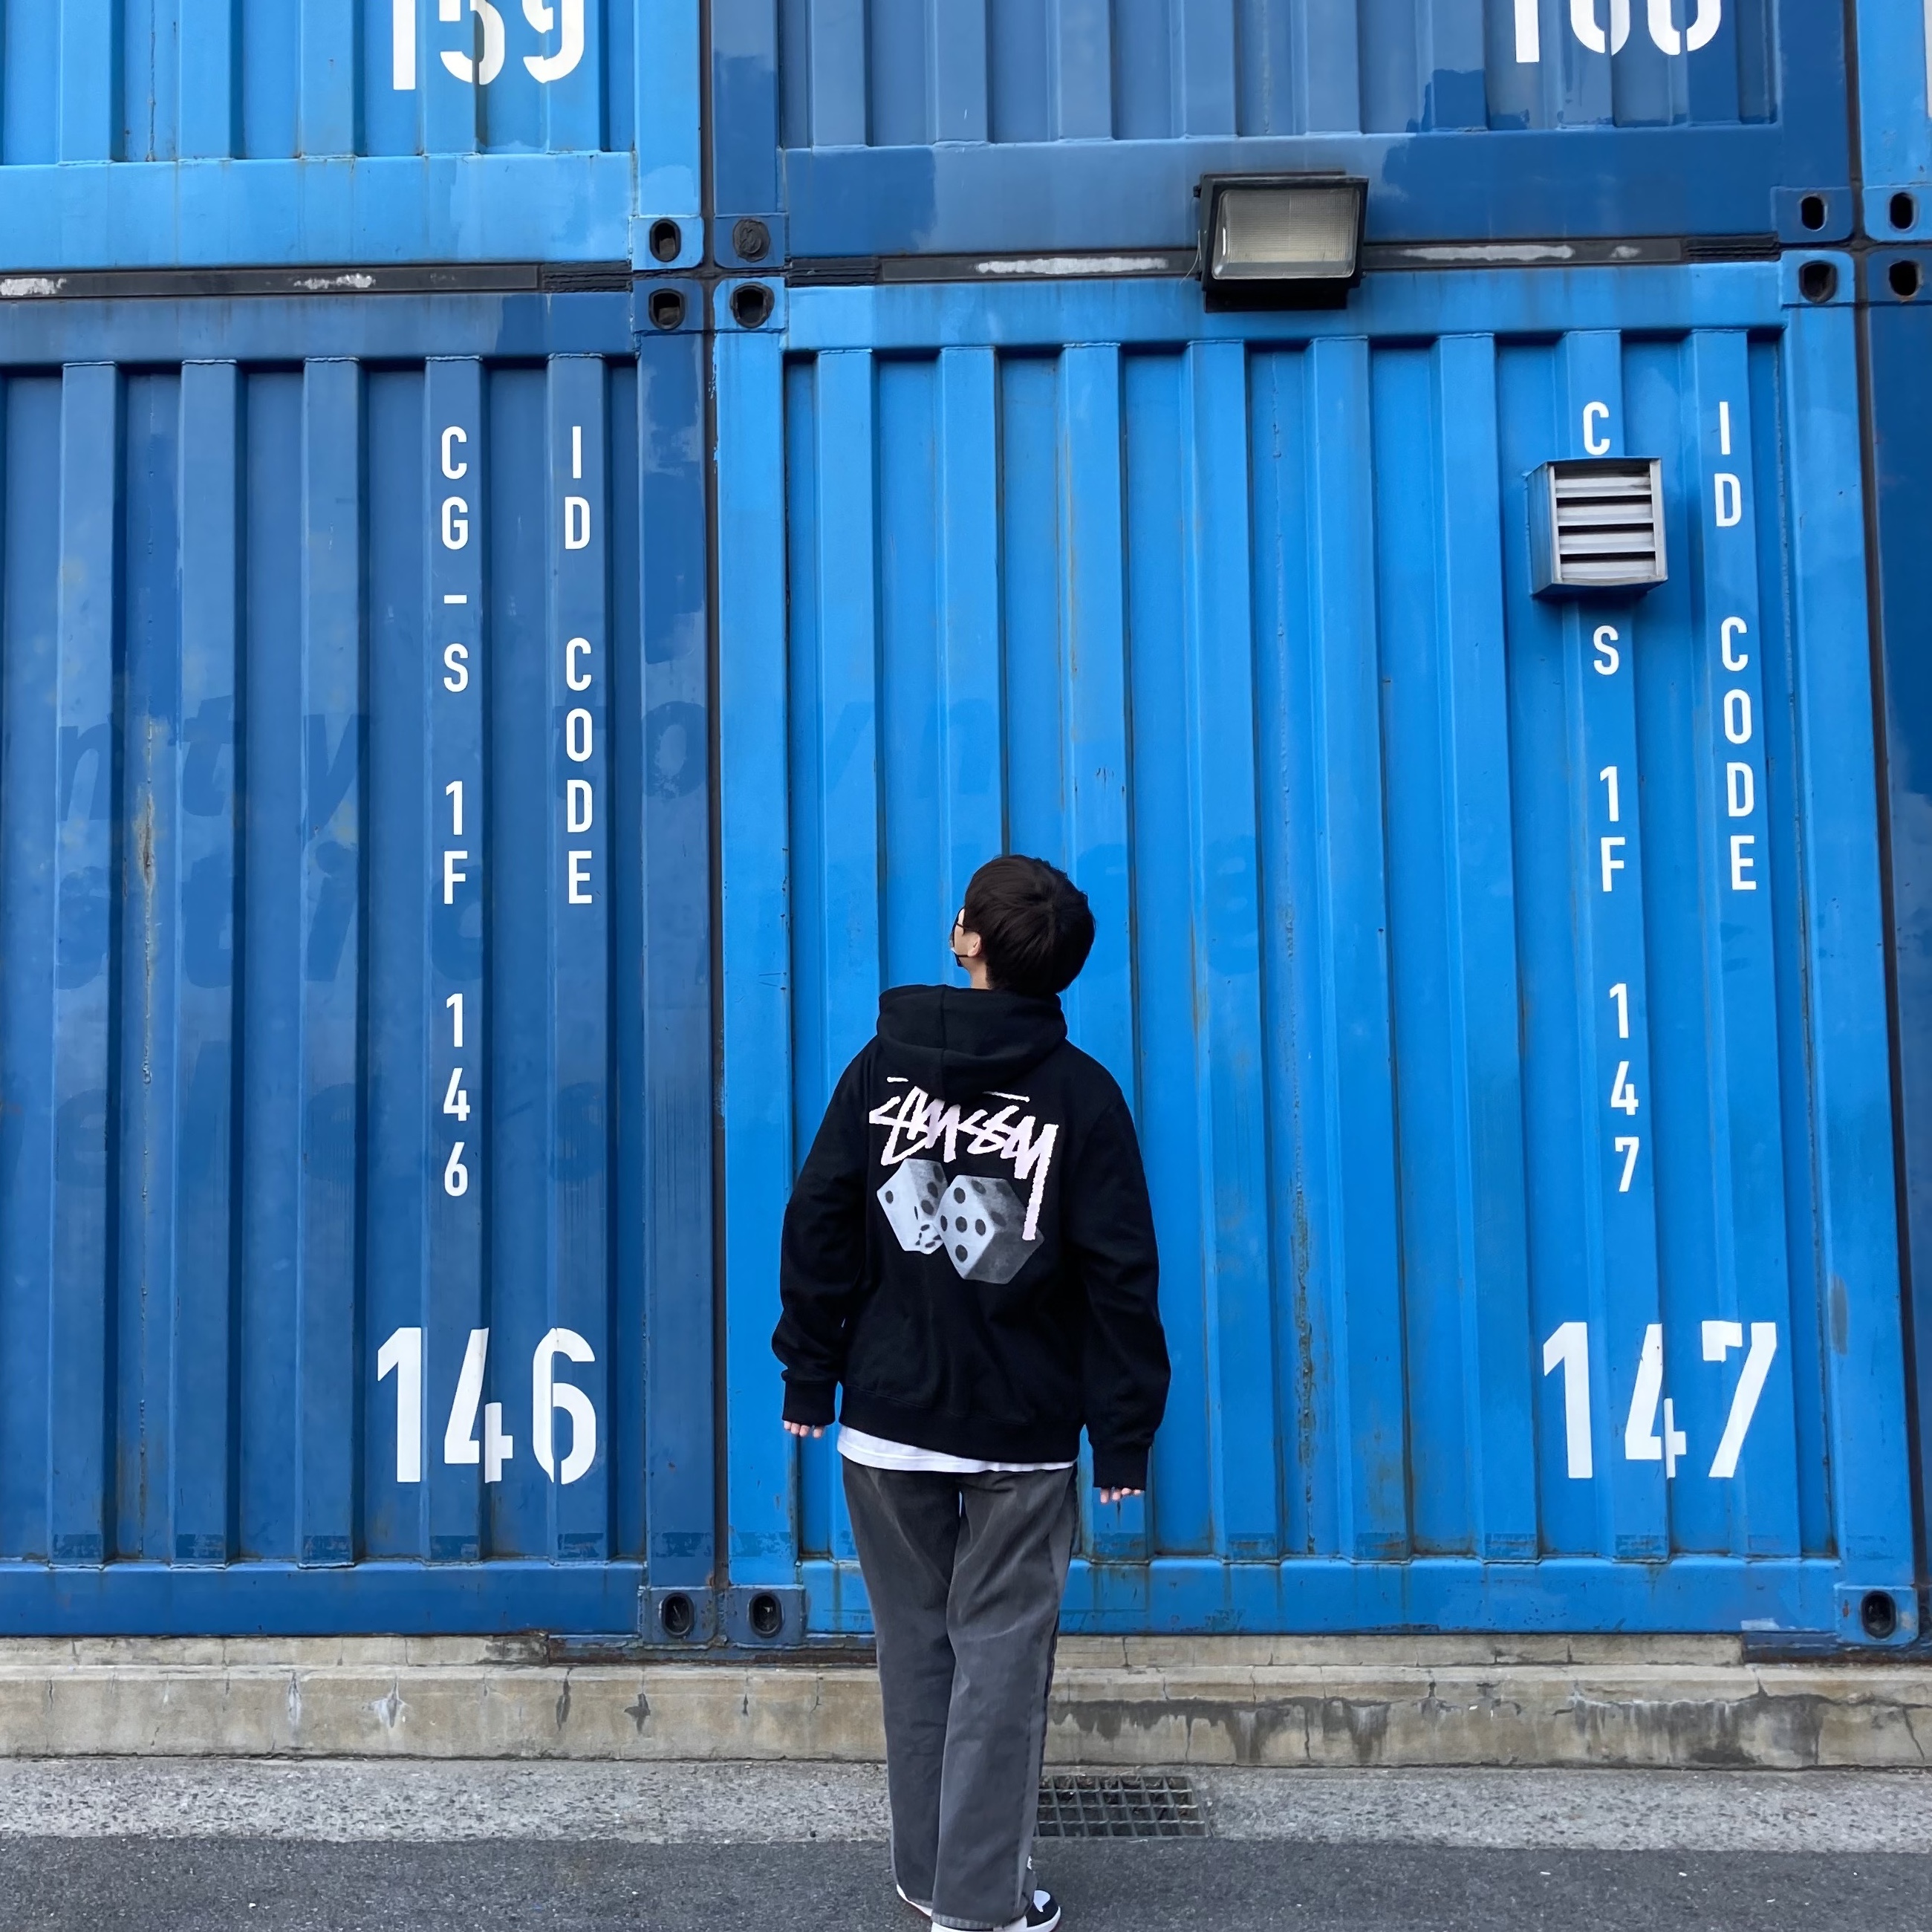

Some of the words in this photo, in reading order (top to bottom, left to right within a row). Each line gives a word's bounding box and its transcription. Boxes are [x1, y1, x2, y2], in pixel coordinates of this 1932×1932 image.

[565, 426, 591, 550] ID
[1714, 401, 1742, 527] ID
[566, 637, 593, 904] CODE
[1600, 766, 1625, 892] 1F
[1721, 617, 1757, 890] CODE
[444, 781, 468, 905] 1F
[443, 993, 470, 1197] 146
[1610, 983, 1639, 1192] 147
[377, 1327, 596, 1485] 146
[1543, 1322, 1777, 1478] 147
